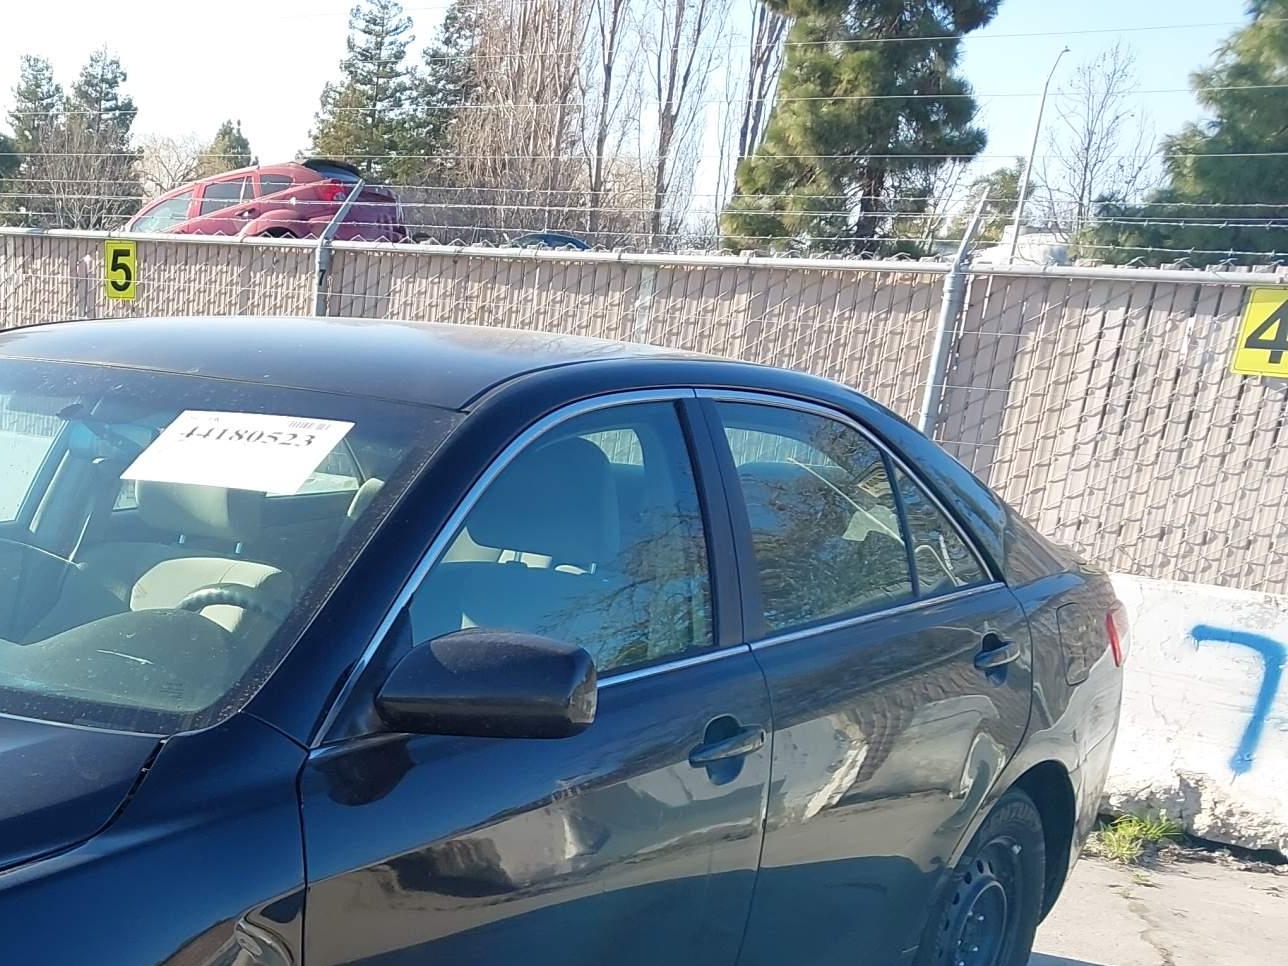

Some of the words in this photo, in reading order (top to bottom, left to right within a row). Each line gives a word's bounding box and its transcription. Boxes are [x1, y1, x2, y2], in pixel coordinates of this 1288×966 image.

[110, 248, 132, 292] 5
[1244, 299, 1288, 365] 4
[177, 425, 316, 448] 44180523
[1190, 623, 1288, 776] 7
